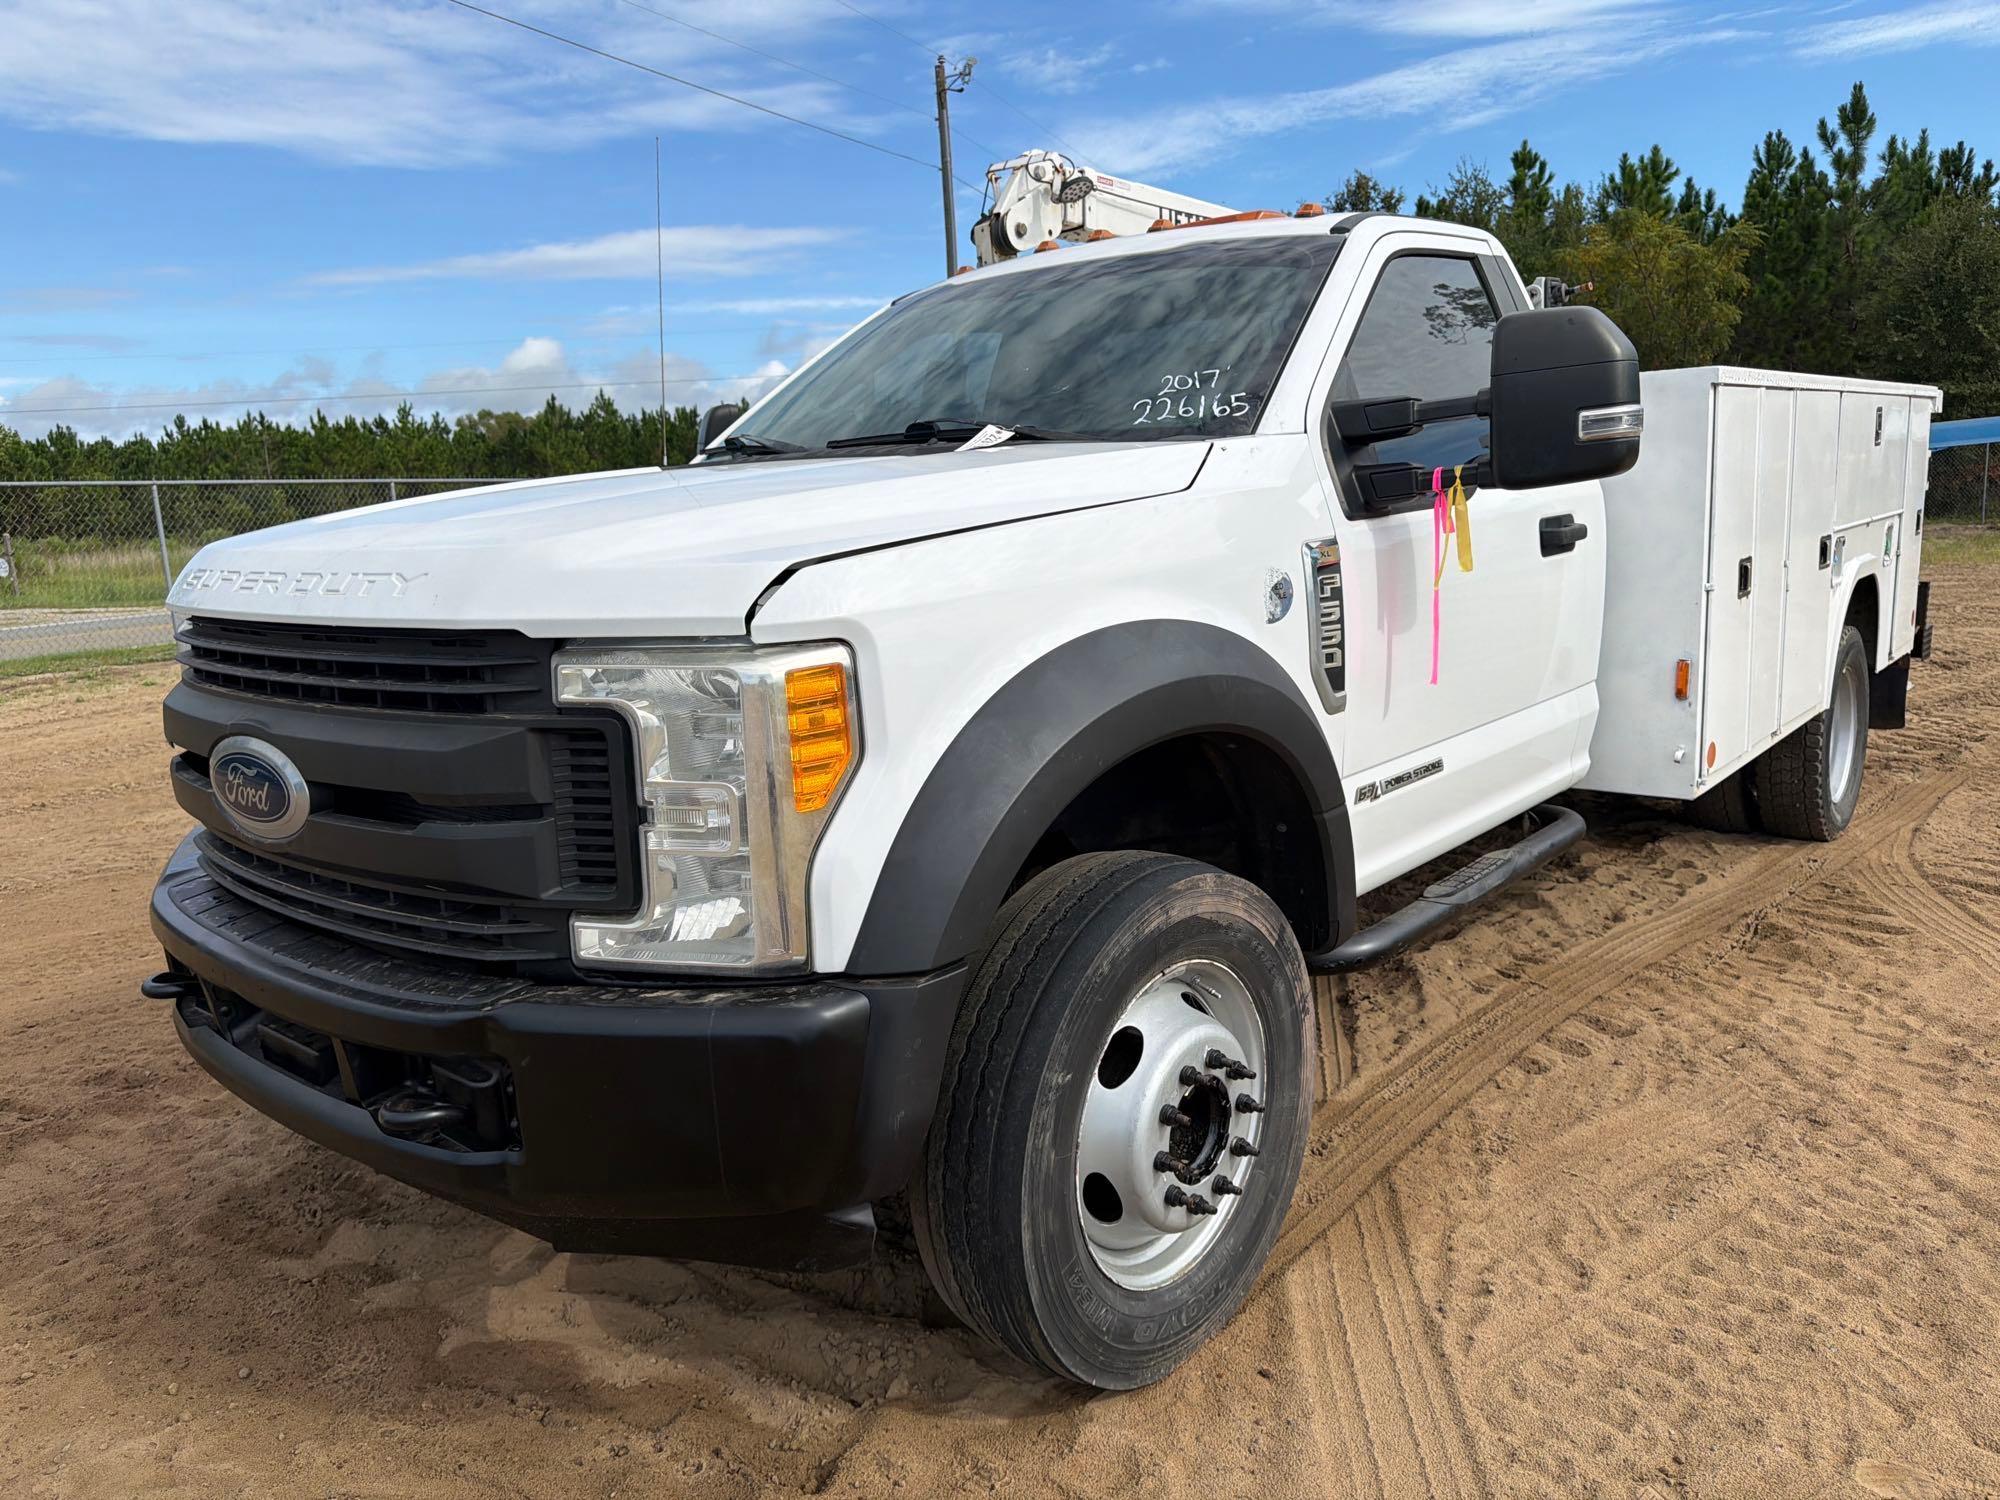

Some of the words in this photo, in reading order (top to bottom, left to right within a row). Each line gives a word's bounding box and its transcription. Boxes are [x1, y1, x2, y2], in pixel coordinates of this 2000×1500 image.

[1132, 392, 1250, 425] 226165
[183, 568, 288, 594] SUPER
[287, 571, 429, 598] DUTY
[225, 762, 270, 812] Ford
[1384, 771, 1413, 790] POWER
[1412, 757, 1444, 779] STROKE
